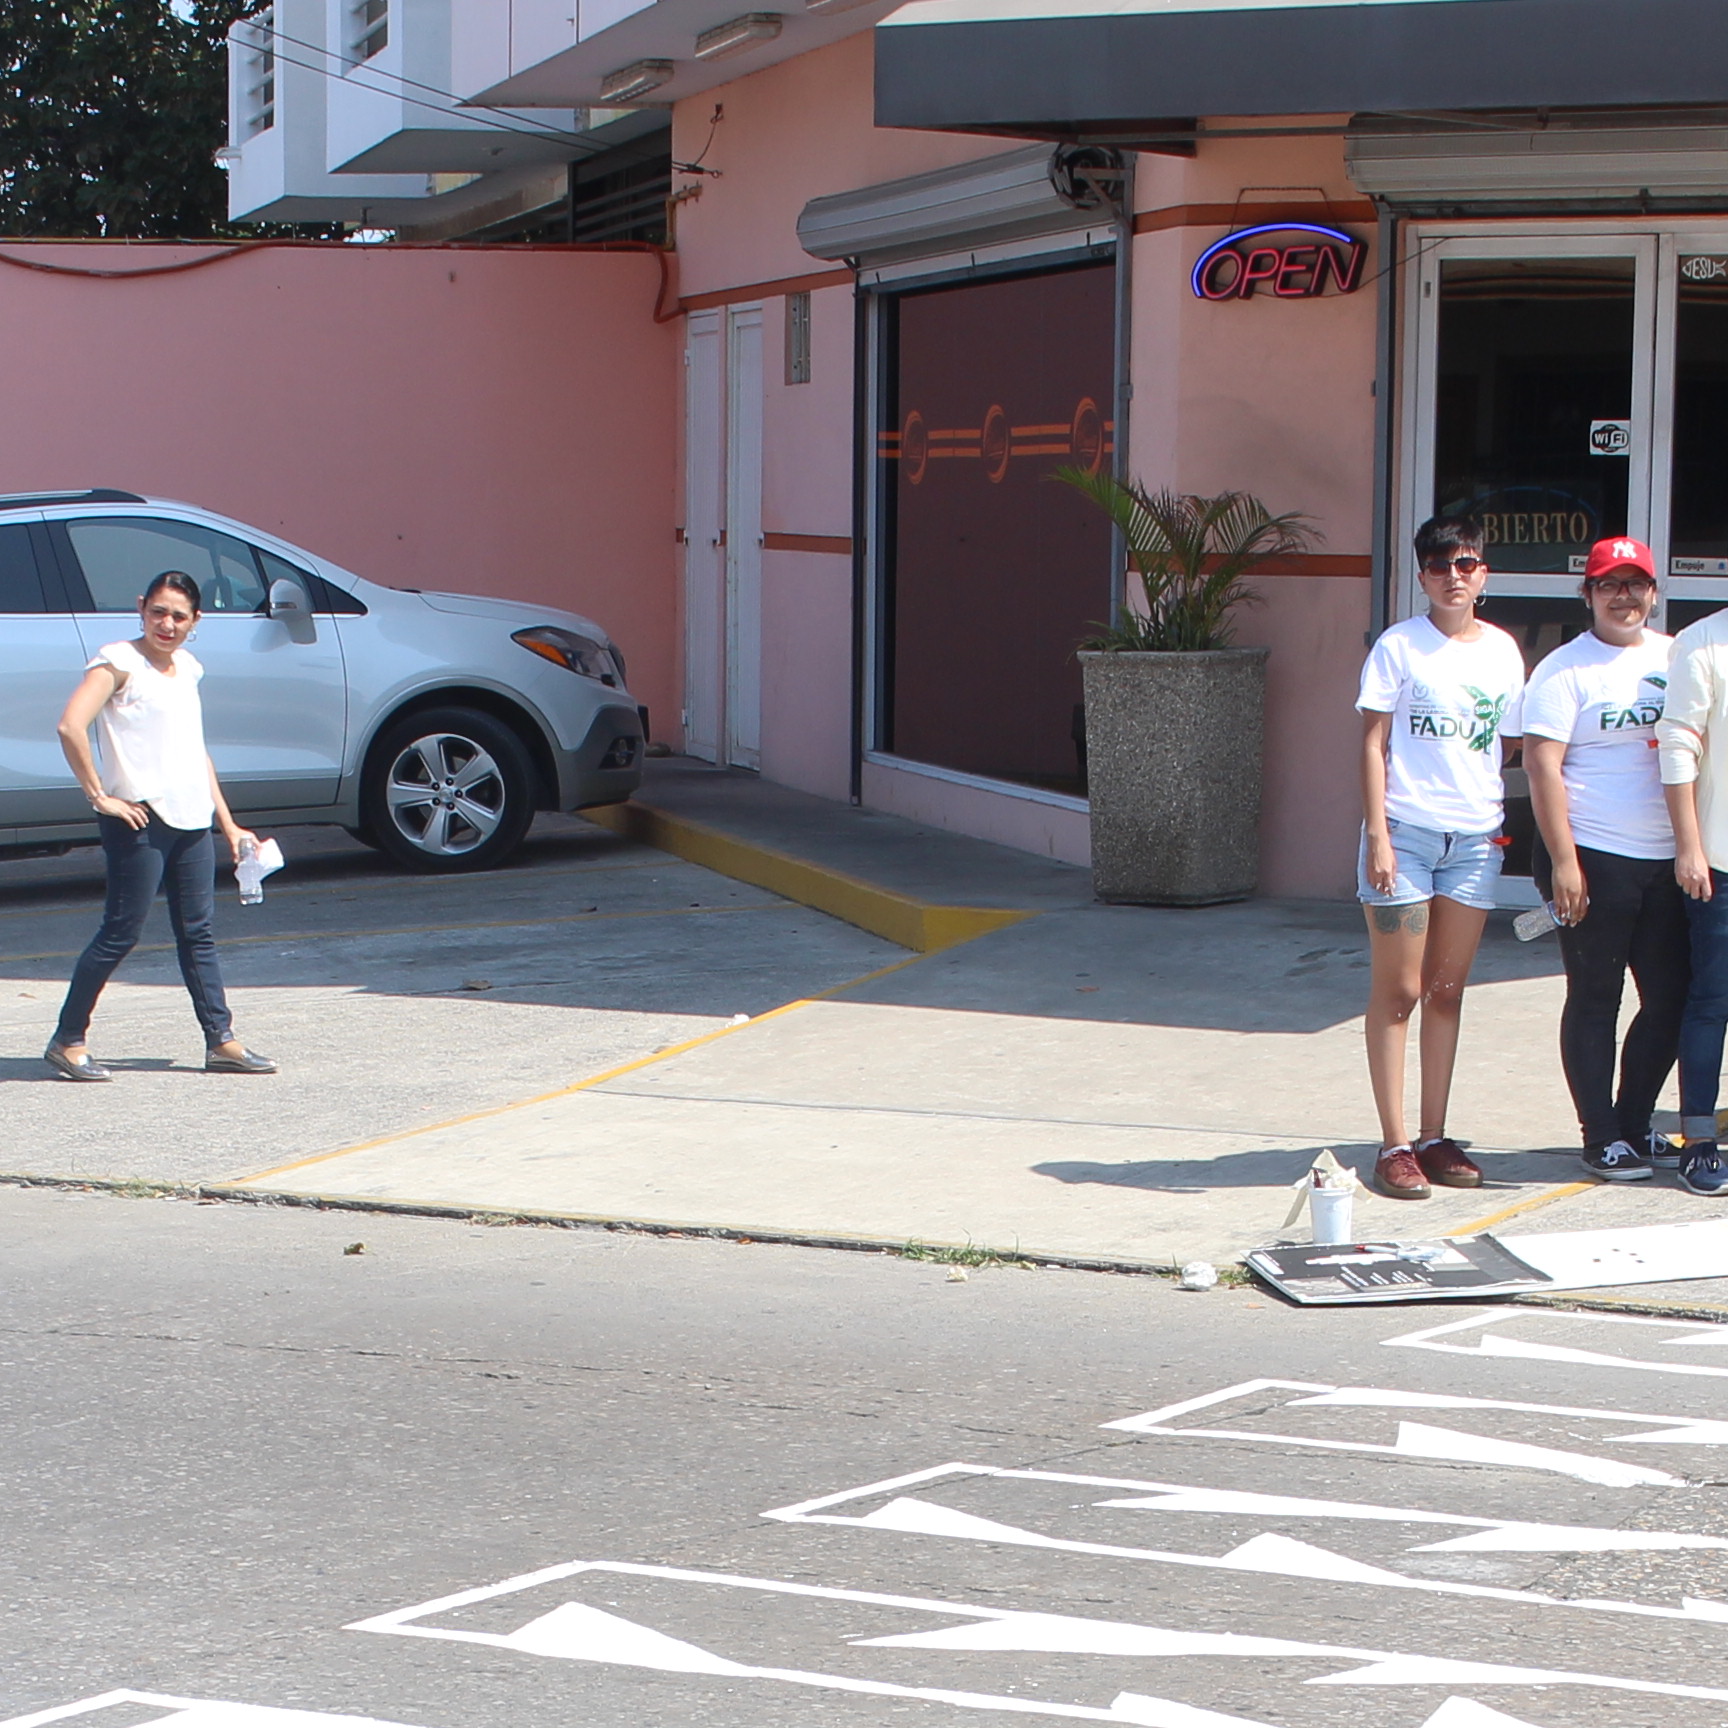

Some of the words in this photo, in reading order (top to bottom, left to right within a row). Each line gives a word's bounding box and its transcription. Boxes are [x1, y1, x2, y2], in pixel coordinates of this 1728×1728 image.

[1200, 243, 1365, 300] OPEN
[1482, 512, 1589, 544] BIERTO
[1675, 560, 1706, 572] Empuje
[1409, 714, 1477, 740] FADU
